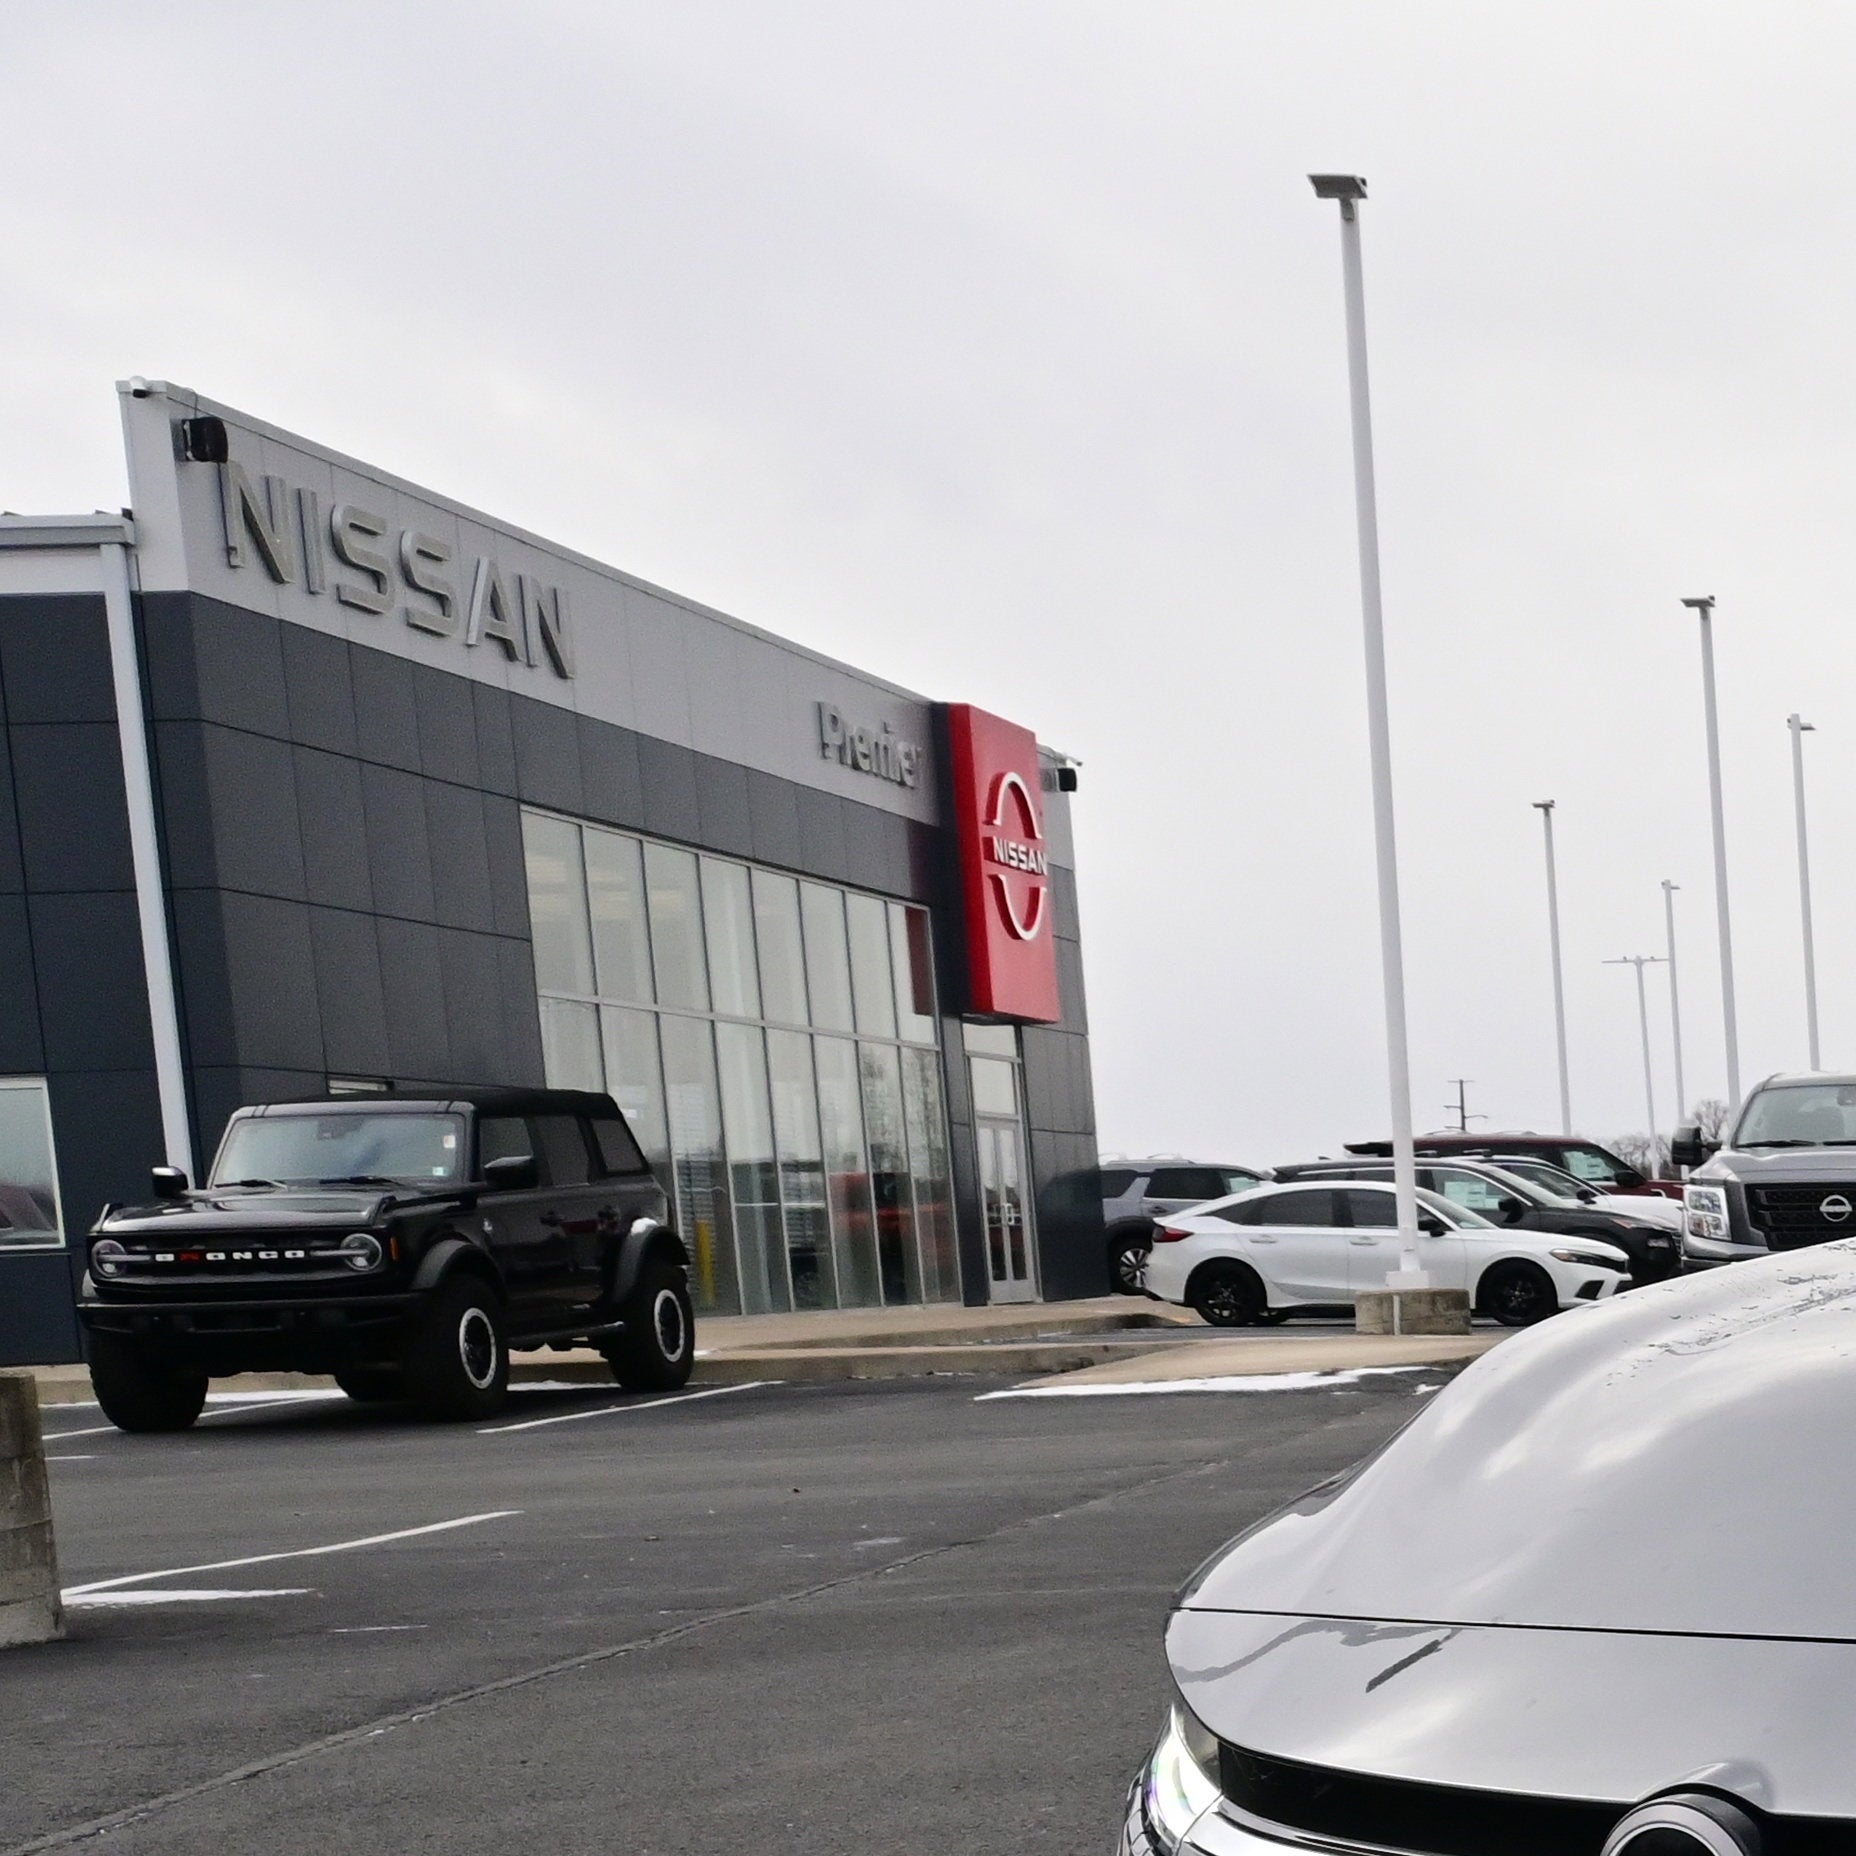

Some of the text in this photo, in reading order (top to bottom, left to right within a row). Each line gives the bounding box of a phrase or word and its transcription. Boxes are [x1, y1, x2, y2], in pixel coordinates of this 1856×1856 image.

[217, 460, 577, 680] NISSAN
[816, 700, 924, 790] Premier
[992, 834, 1048, 876] NISSAN
[154, 1250, 305, 1262] BRONCO
